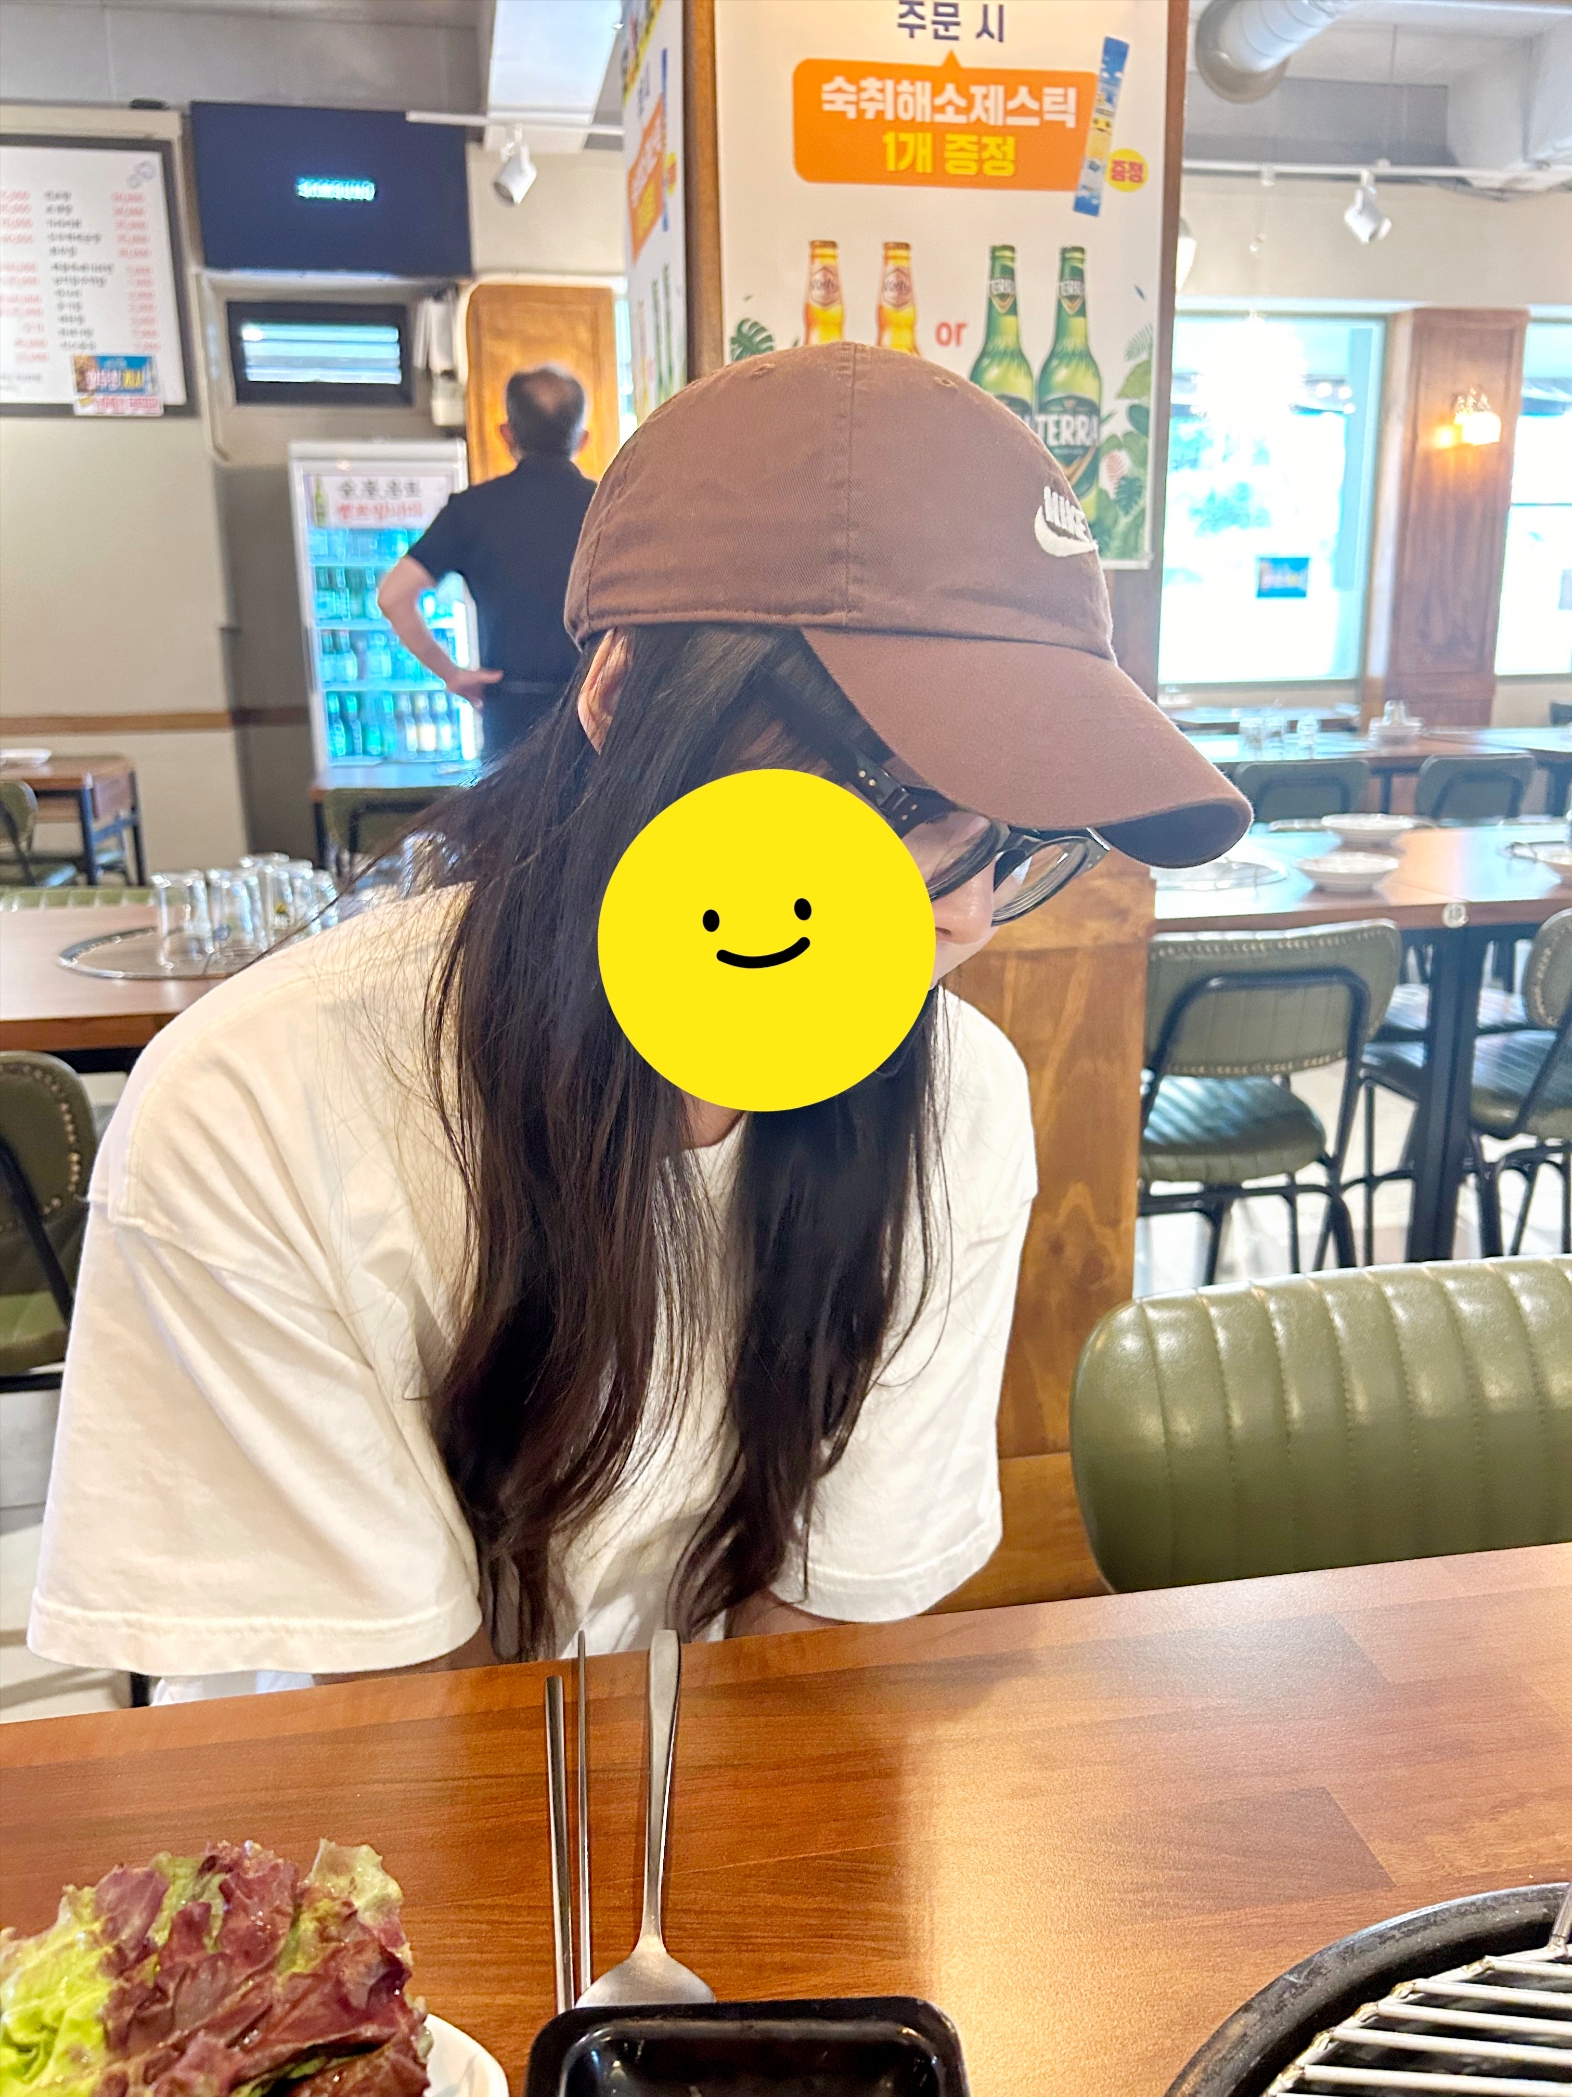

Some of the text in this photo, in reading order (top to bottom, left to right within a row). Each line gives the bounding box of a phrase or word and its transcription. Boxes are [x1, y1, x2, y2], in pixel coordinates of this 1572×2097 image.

[897, 0, 1004, 43] 주문 시
[821, 75, 1078, 129] 숙취해소제스틱
[882, 130, 1017, 177] 1개 증정
[1110, 158, 1145, 184] 증정
[935, 321, 968, 347] or
[1034, 413, 1099, 447] TERRA
[1043, 486, 1090, 542] NIKE
